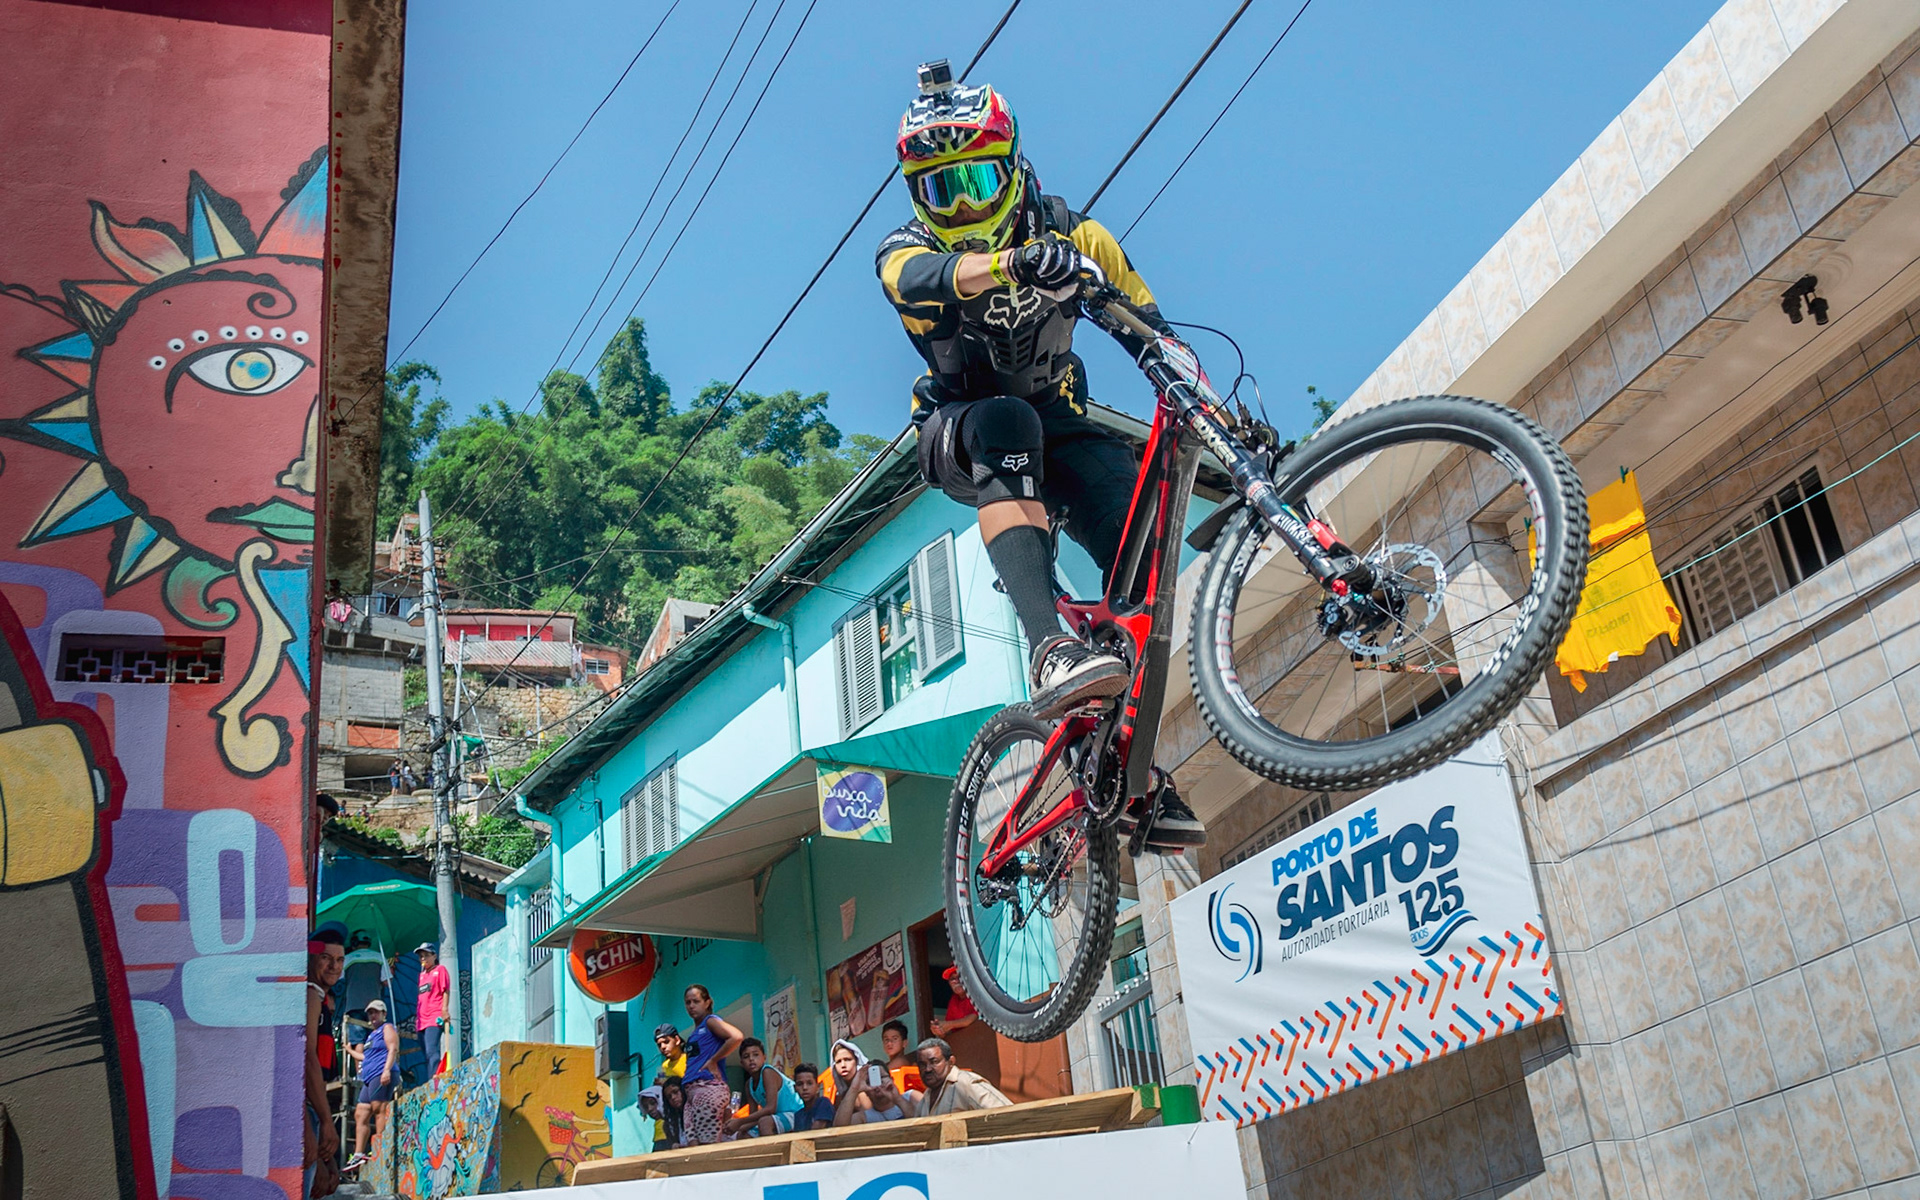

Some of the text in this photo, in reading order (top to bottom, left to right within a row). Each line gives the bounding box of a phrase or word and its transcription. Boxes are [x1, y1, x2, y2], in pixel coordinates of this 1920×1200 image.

[979, 750, 993, 770] DT
[822, 781, 872, 803] busca
[965, 764, 985, 801] SWISS
[837, 802, 886, 823] vida
[1271, 807, 1379, 887] PORTO DE
[1276, 805, 1459, 941] SANTOS
[1398, 868, 1464, 932] 125
[1281, 900, 1390, 963] AUTORIDADE PORTUÁRIA
[1410, 926, 1429, 944] anos
[586, 937, 644, 976] SCHIN
